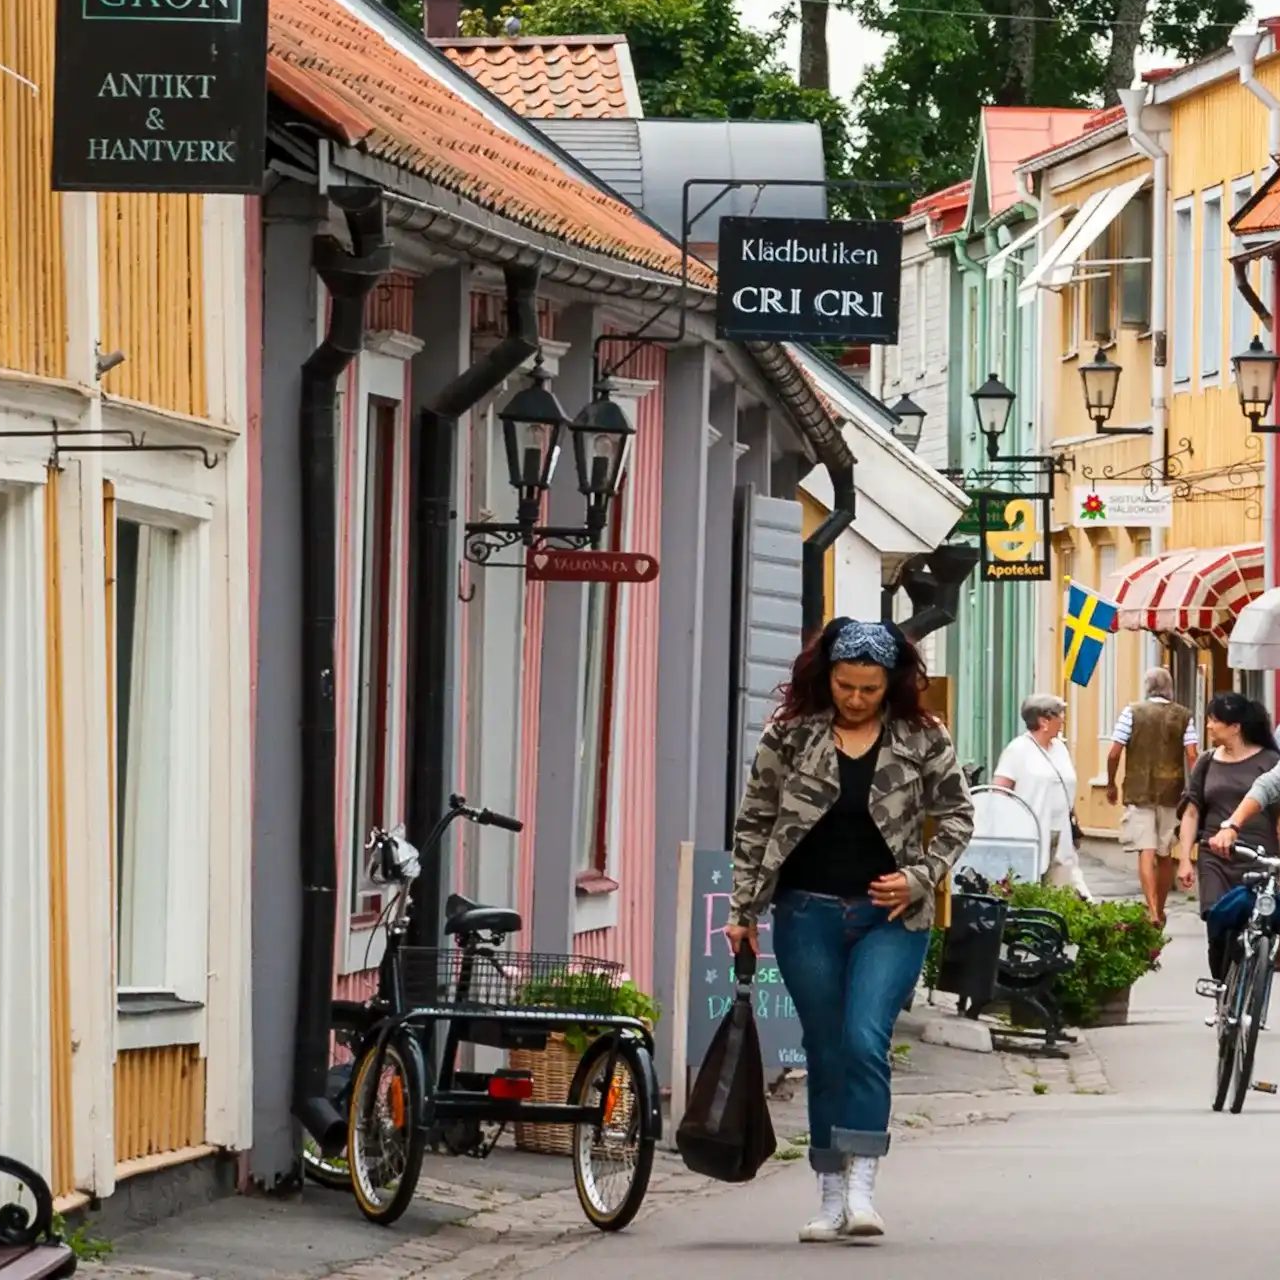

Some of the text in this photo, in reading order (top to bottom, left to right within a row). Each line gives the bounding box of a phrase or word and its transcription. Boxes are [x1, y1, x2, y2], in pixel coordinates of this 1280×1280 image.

[98, 72, 216, 98] ANTIKT
[145, 107, 165, 130] &
[87, 138, 236, 163] HANTVERK
[742, 238, 878, 265] Klädbutiken
[732, 286, 883, 318] CRI CRI
[987, 563, 1045, 579] Apoteket
